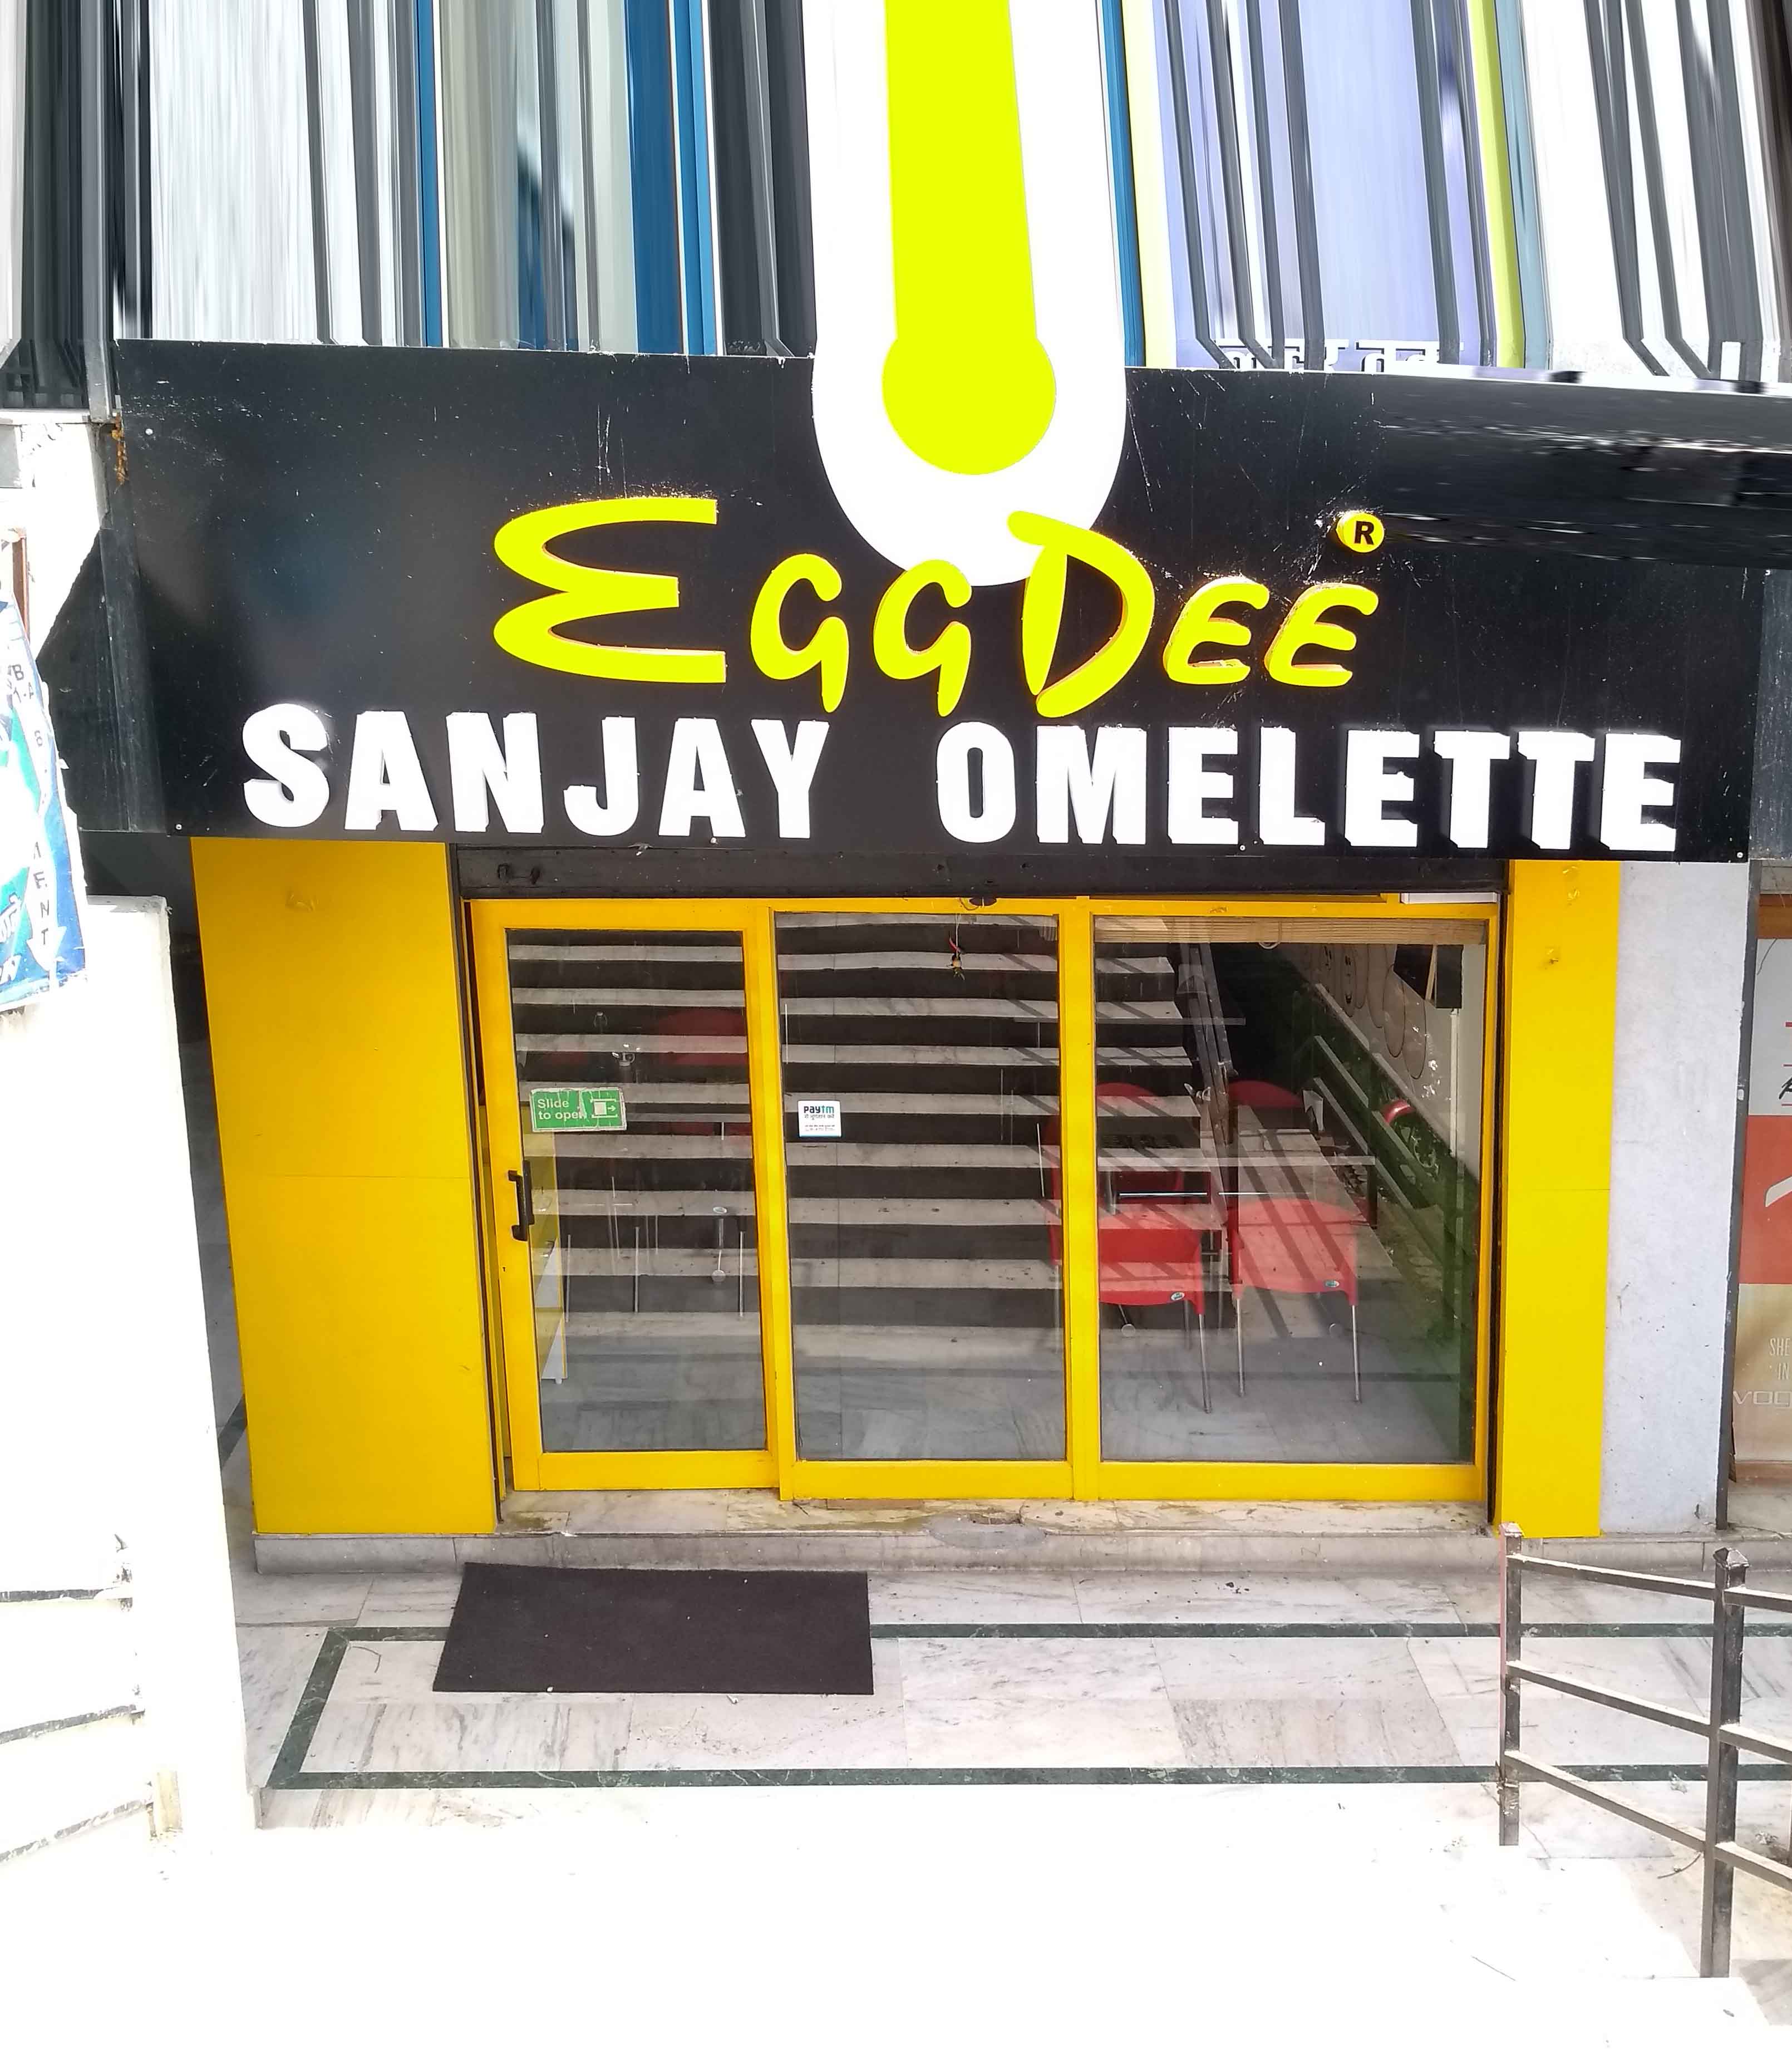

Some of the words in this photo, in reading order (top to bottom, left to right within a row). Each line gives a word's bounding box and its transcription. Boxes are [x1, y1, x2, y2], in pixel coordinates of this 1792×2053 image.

[242, 703, 830, 839] SANJAY
[936, 721, 1681, 851] OMELETTE
[538, 1099, 569, 1109] Slide
[538, 1111, 551, 1120] to
[555, 1111, 587, 1122] open
[1778, 1363, 1789, 1380] IN
